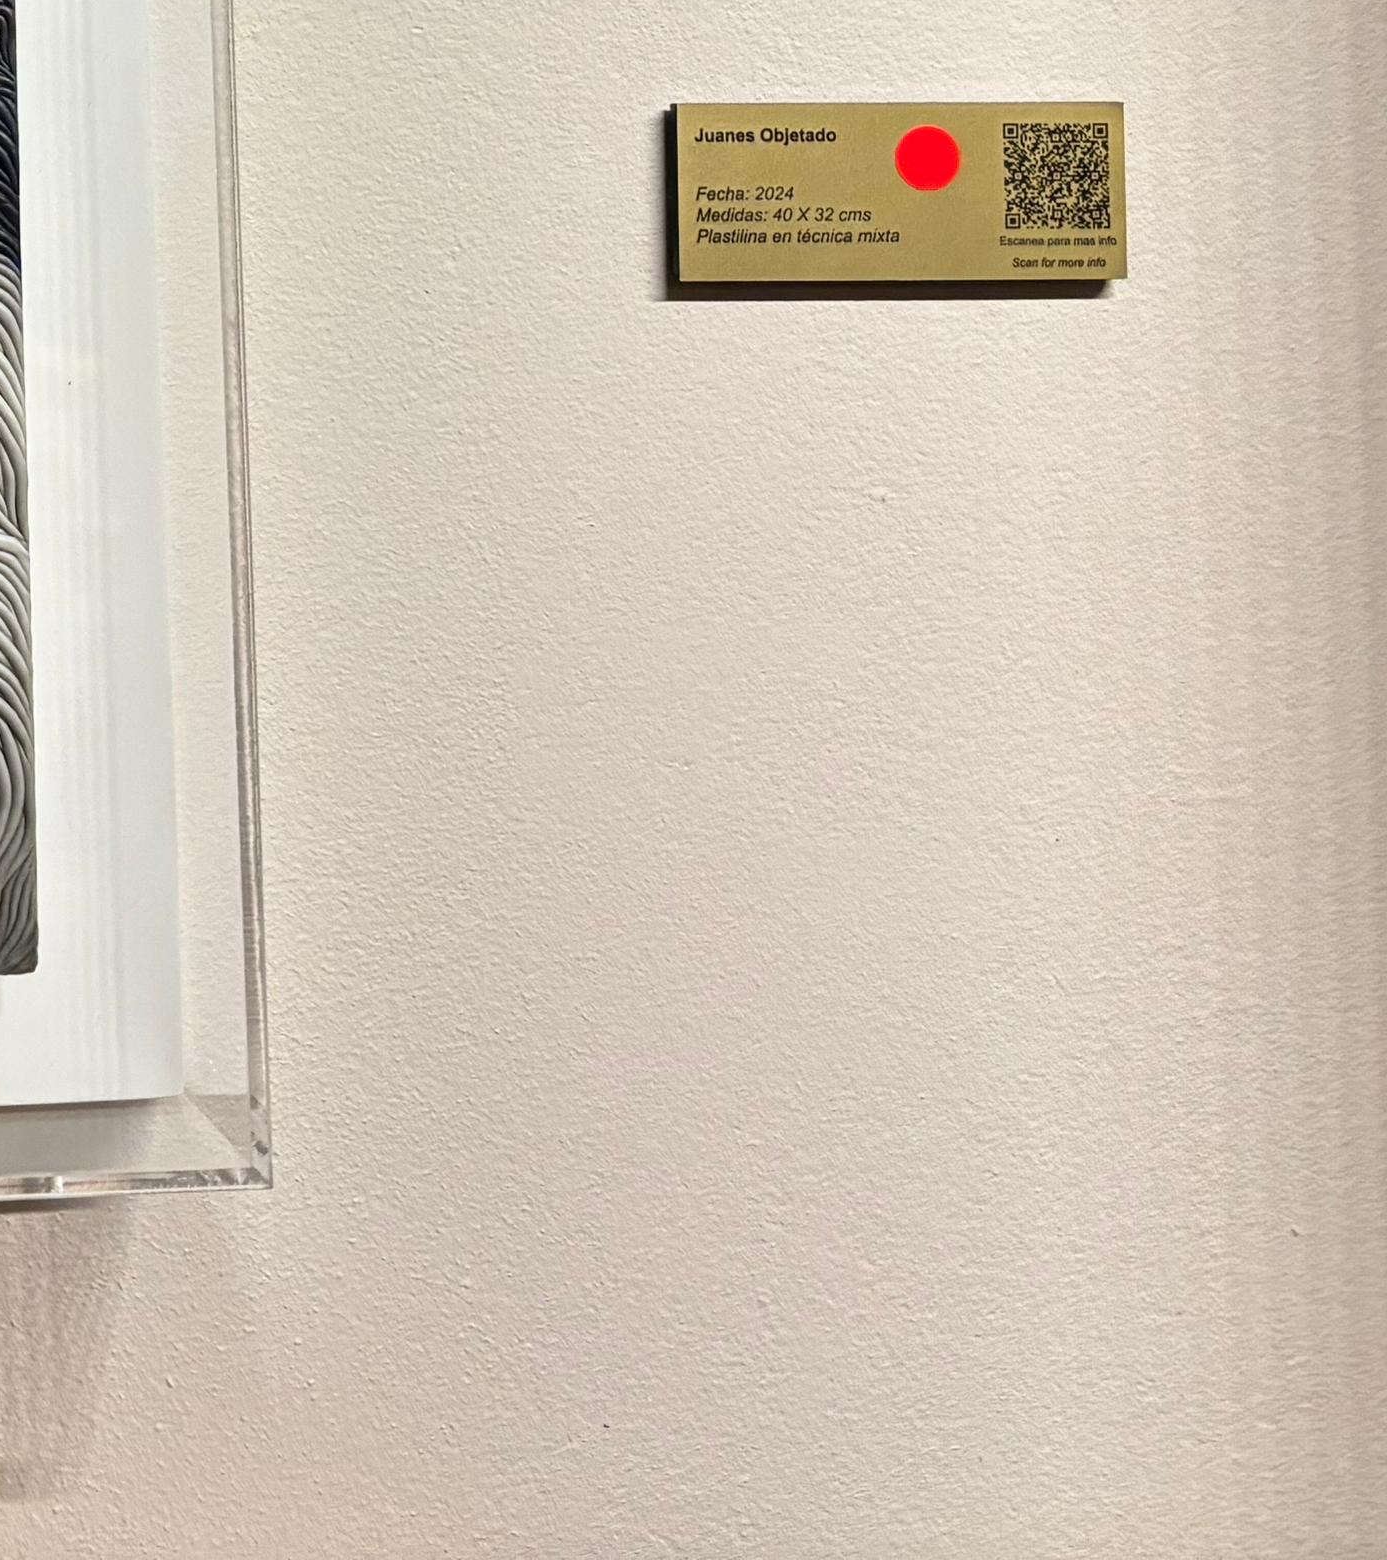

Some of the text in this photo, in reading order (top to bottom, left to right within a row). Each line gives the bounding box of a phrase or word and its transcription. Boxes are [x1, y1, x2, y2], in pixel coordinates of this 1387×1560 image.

[694, 127, 837, 146] Juanes Objetado
[696, 186, 794, 201] Fecha: 2024
[696, 207, 768, 223] Medidas:
[773, 207, 793, 222] 40
[815, 207, 834, 222] 32
[839, 209, 872, 222] cms
[697, 228, 900, 244] Plastilina en técnica mixta
[1098, 236, 1117, 247] info
[1012, 257, 1107, 268] Scan for more info
